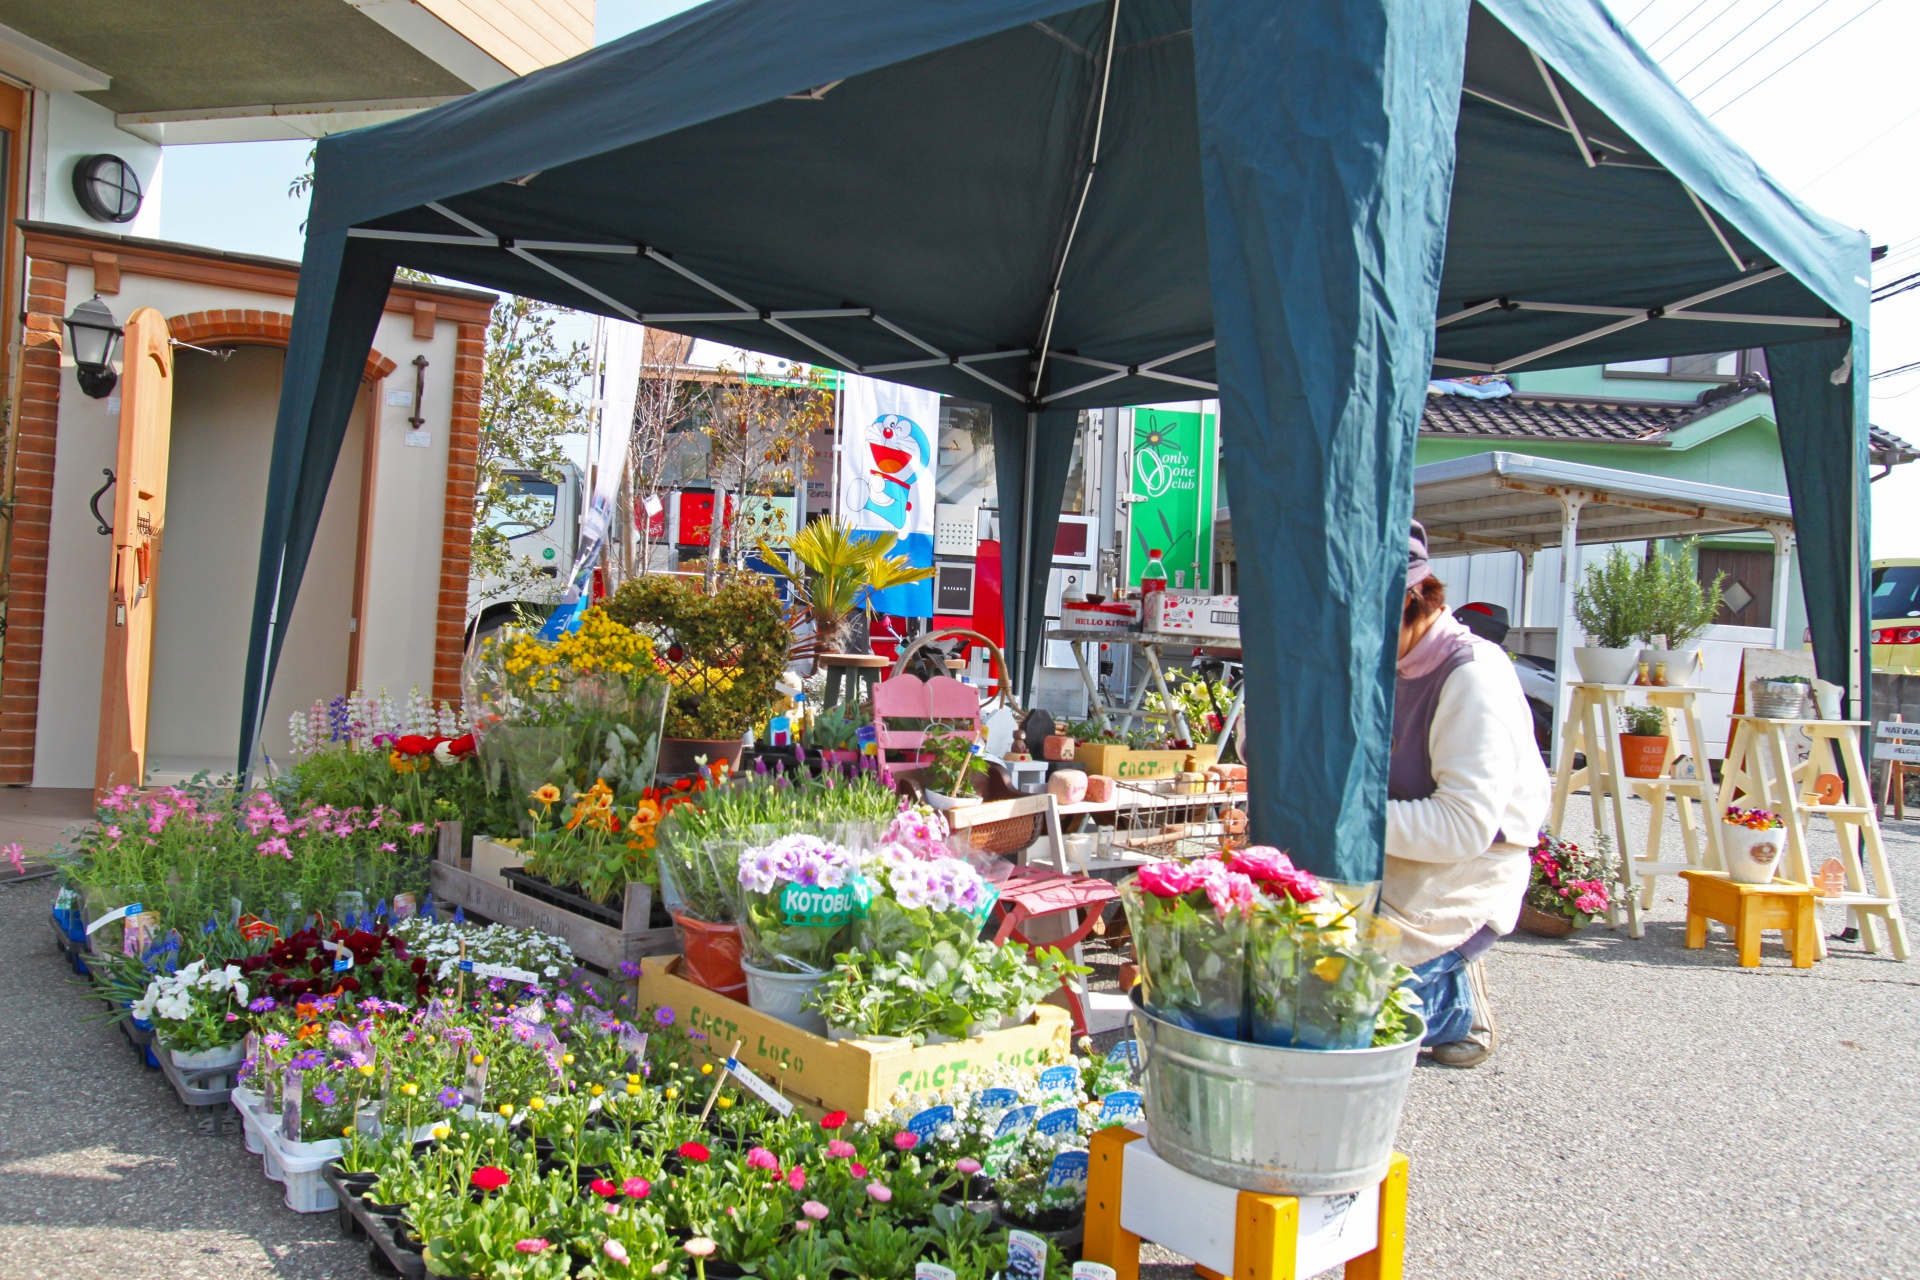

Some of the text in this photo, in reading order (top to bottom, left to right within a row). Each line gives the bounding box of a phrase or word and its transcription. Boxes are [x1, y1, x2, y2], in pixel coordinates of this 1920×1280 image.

[1162, 451, 1189, 467] only
[1172, 466, 1195, 477] one
[1171, 477, 1195, 490] club
[1075, 617, 1103, 626] HELLO
[1885, 726, 1920, 736] NATURA
